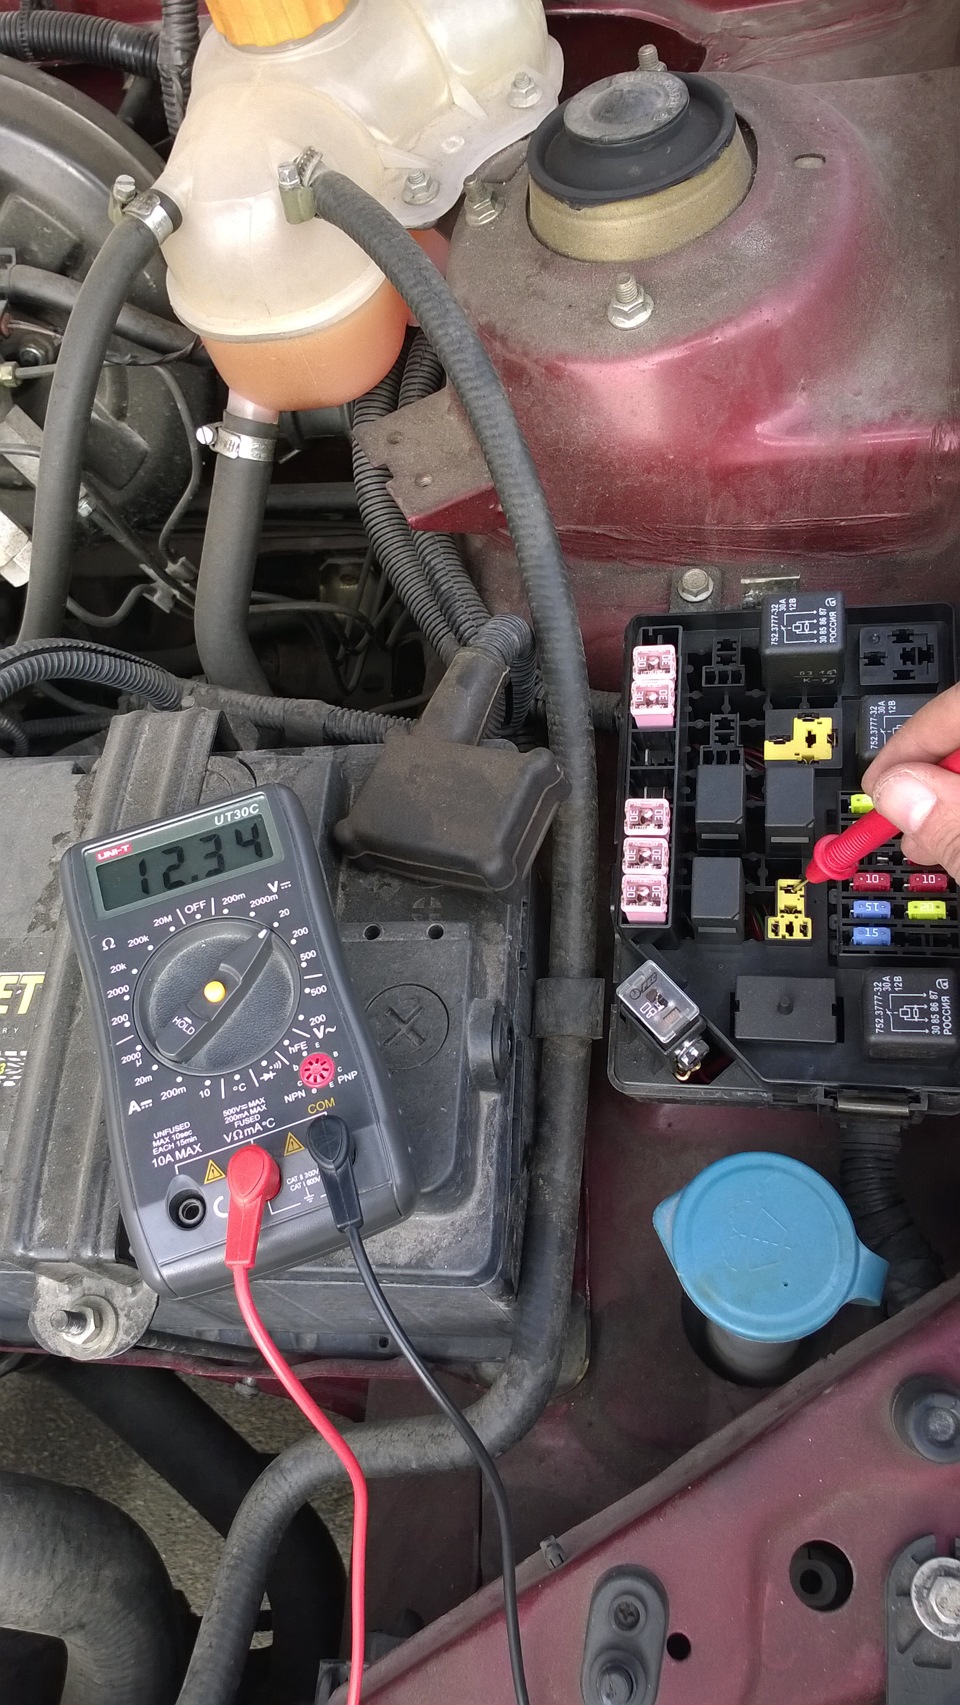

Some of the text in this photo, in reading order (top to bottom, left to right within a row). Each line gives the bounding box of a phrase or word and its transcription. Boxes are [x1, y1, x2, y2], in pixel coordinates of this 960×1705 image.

[771, 604, 779, 645] 752.3777-32
[819, 617, 827, 625] 86
[829, 611, 837, 643] РОССИЯ
[819, 626, 827, 634] 85
[870, 706, 878, 749] 752.3777-32
[214, 804, 260, 826] UT30C
[97, 844, 130, 860] UNI-T
[138, 823, 264, 895] 12.34
[866, 874, 879, 883] 10
[922, 874, 936, 884] 10
[222, 892, 246, 906] 200m
[250, 893, 278, 908] 2000m
[184, 900, 206, 914] OFF
[279, 908, 290, 918] 20
[153, 914, 172, 927] 20M
[292, 927, 308, 938] 200
[865, 928, 879, 937] 15
[127, 936, 149, 948] 200k
[300, 950, 317, 961] 500
[110, 963, 127, 974] 20k
[107, 985, 129, 998] 2000
[310, 984, 327, 996] 500
[930, 990, 940, 1035] 30 85 86 87
[942, 996, 952, 1035] РОССИЯ
[111, 1014, 129, 1025] 200
[172, 1016, 196, 1035] HOLD
[309, 1014, 326, 1026] 200
[288, 1041, 308, 1055] hFE
[121, 1052, 141, 1064] 2000
[134, 1075, 152, 1086] 20m
[338, 1070, 358, 1085] PNP
[160, 1086, 186, 1100] 200m
[199, 1088, 210, 1099] 10
[284, 1090, 306, 1103] NPN
[248, 1097, 266, 1109] MAX
[307, 1098, 335, 1114] COM
[224, 1104, 267, 1123] 200mA MAX
[234, 1114, 261, 1128] FUSED
[153, 1121, 191, 1138] UNFUSED
[152, 1129, 193, 1148] MAX 10sec
[152, 1135, 198, 1155] EACH 15min
[151, 1143, 203, 1168] 10A MAX
[287, 1176, 298, 1184] CAT
[290, 1182, 302, 1192] CAT
